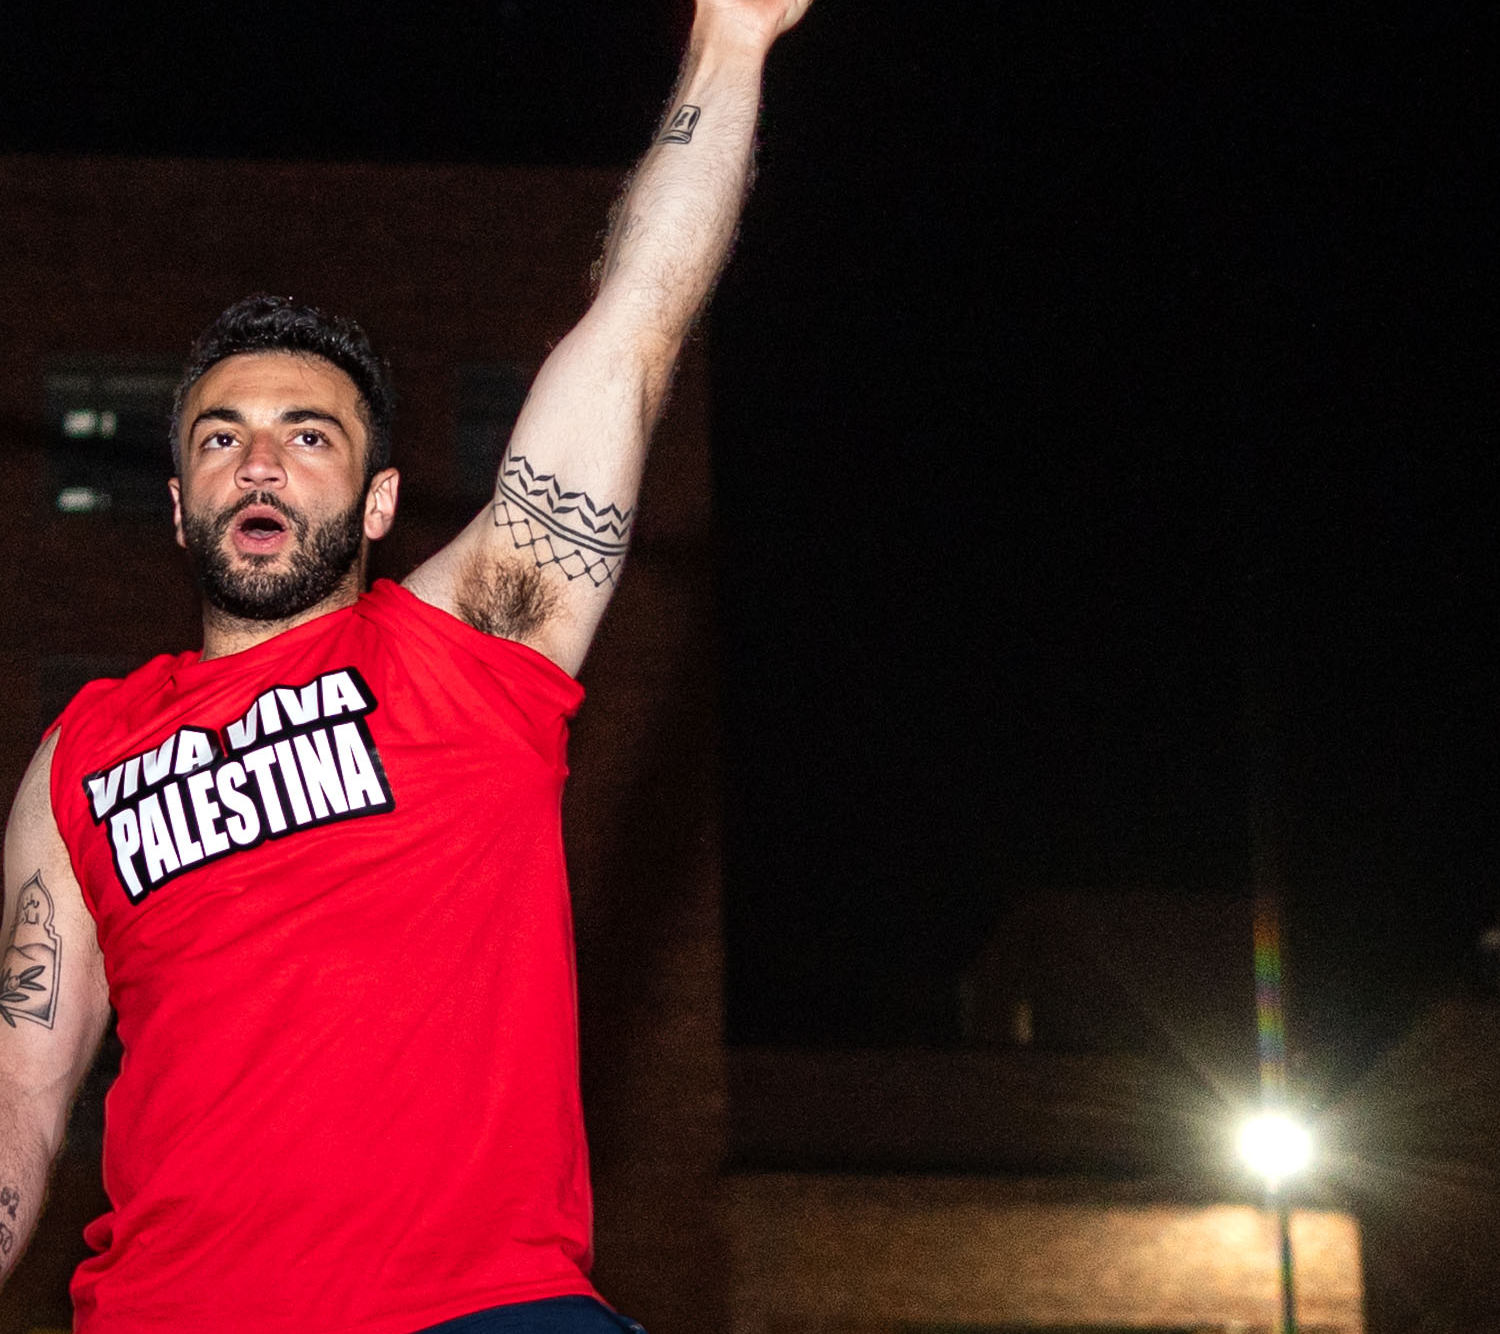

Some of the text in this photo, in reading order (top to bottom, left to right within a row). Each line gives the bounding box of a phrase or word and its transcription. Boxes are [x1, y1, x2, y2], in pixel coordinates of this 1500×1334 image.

[88, 670, 368, 818] VIVA VIVA
[110, 720, 387, 898] PALESTINA
